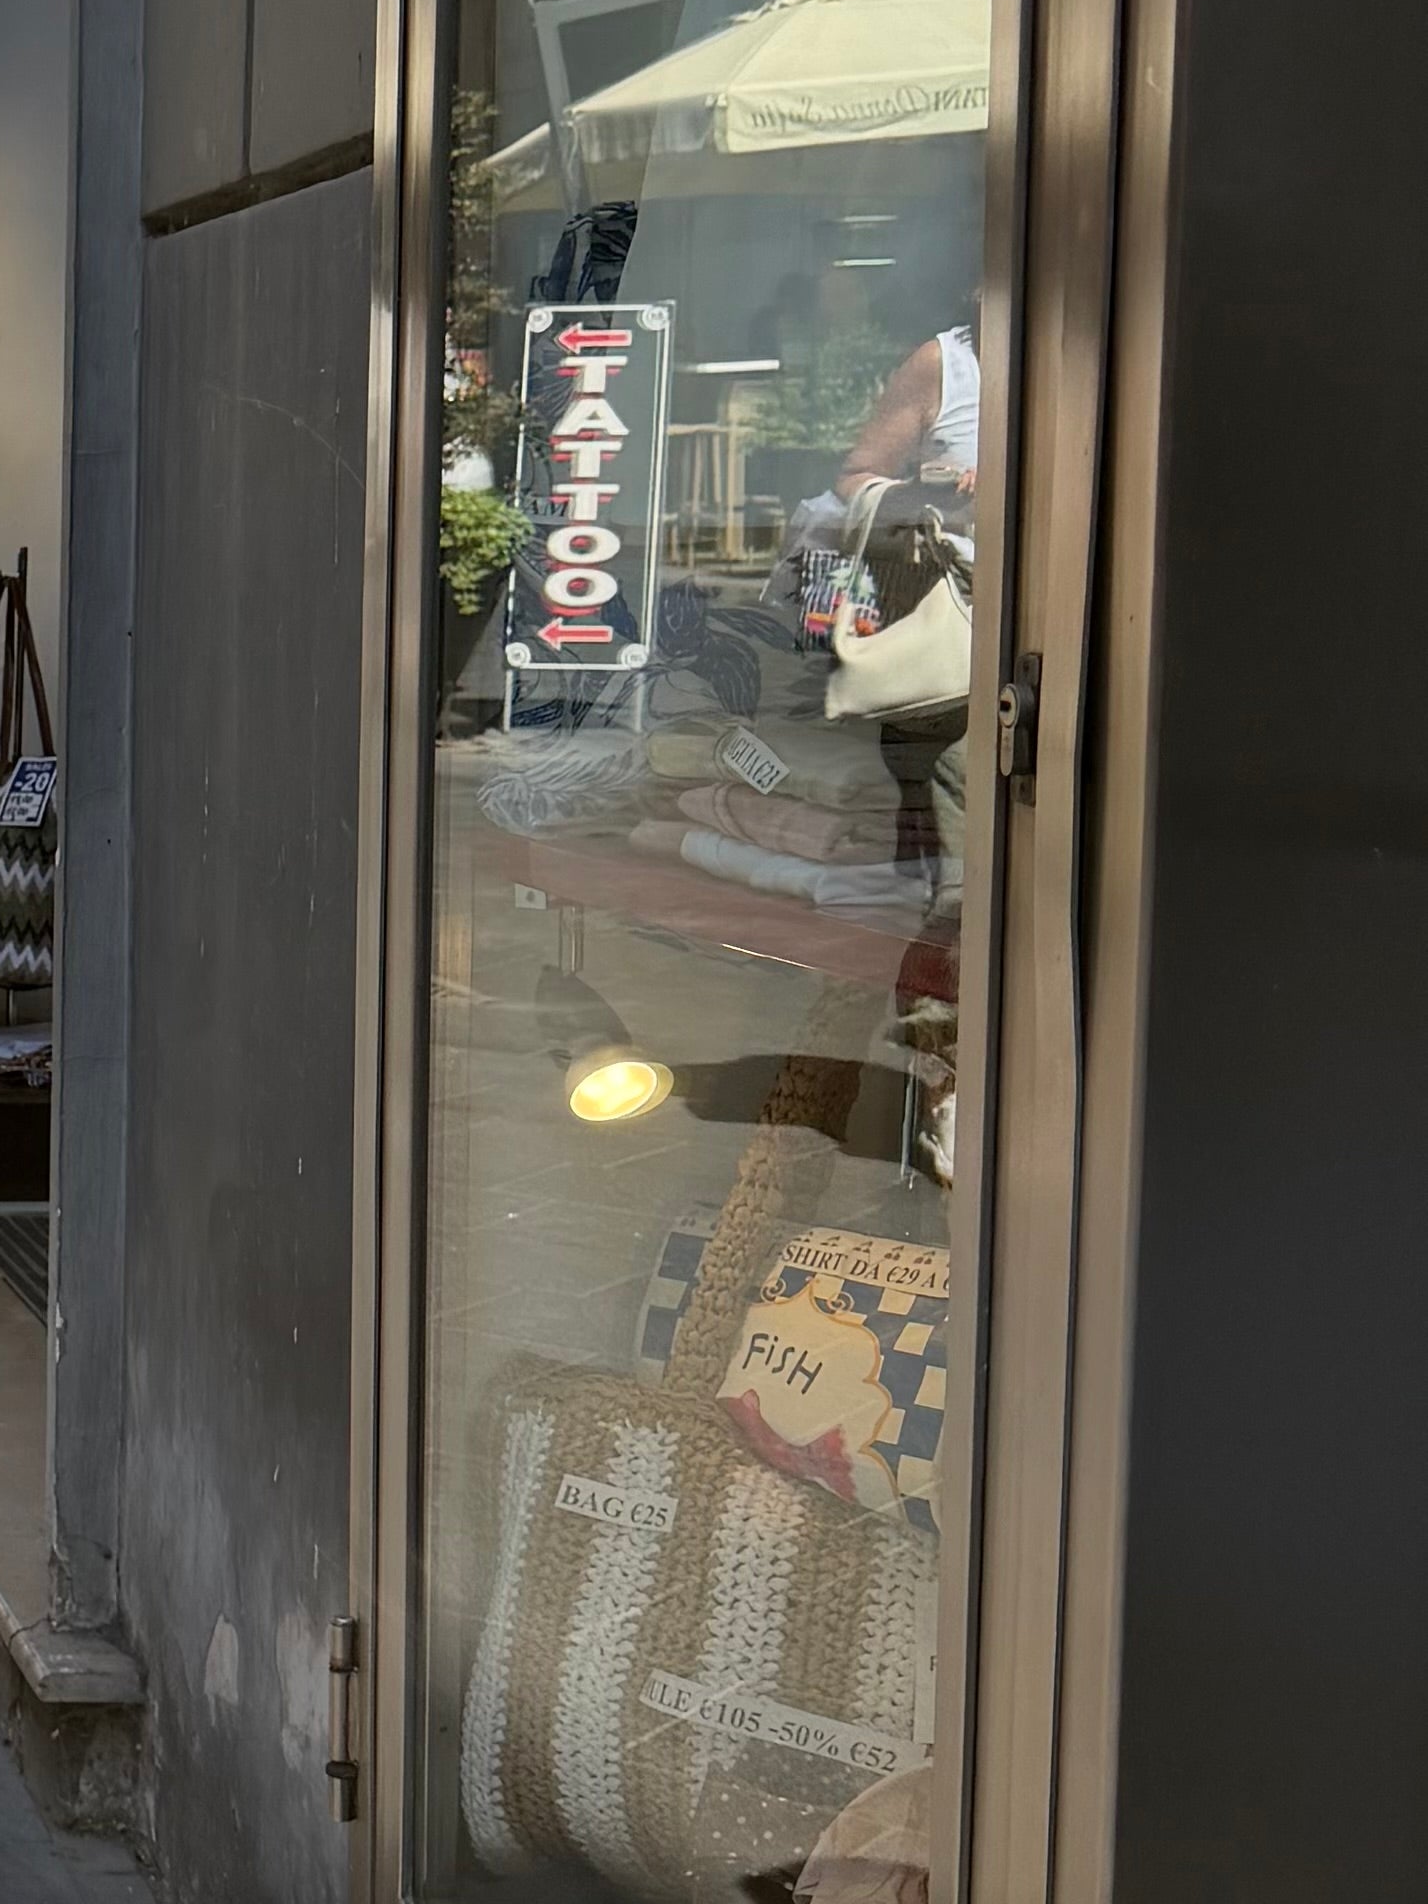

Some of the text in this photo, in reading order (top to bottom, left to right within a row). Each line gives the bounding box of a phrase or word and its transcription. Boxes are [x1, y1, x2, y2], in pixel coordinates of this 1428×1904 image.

[545, 354, 630, 608] TATTOO
[14, 772, 50, 792] -20
[849, 1258, 880, 1282] DA
[885, 1265, 920, 1286] €29
[920, 1270, 936, 1289] A
[561, 1484, 669, 1528] BAG €25
[699, 1697, 763, 1734] €105
[767, 1721, 840, 1758] -50%
[849, 1741, 898, 1772] €52
